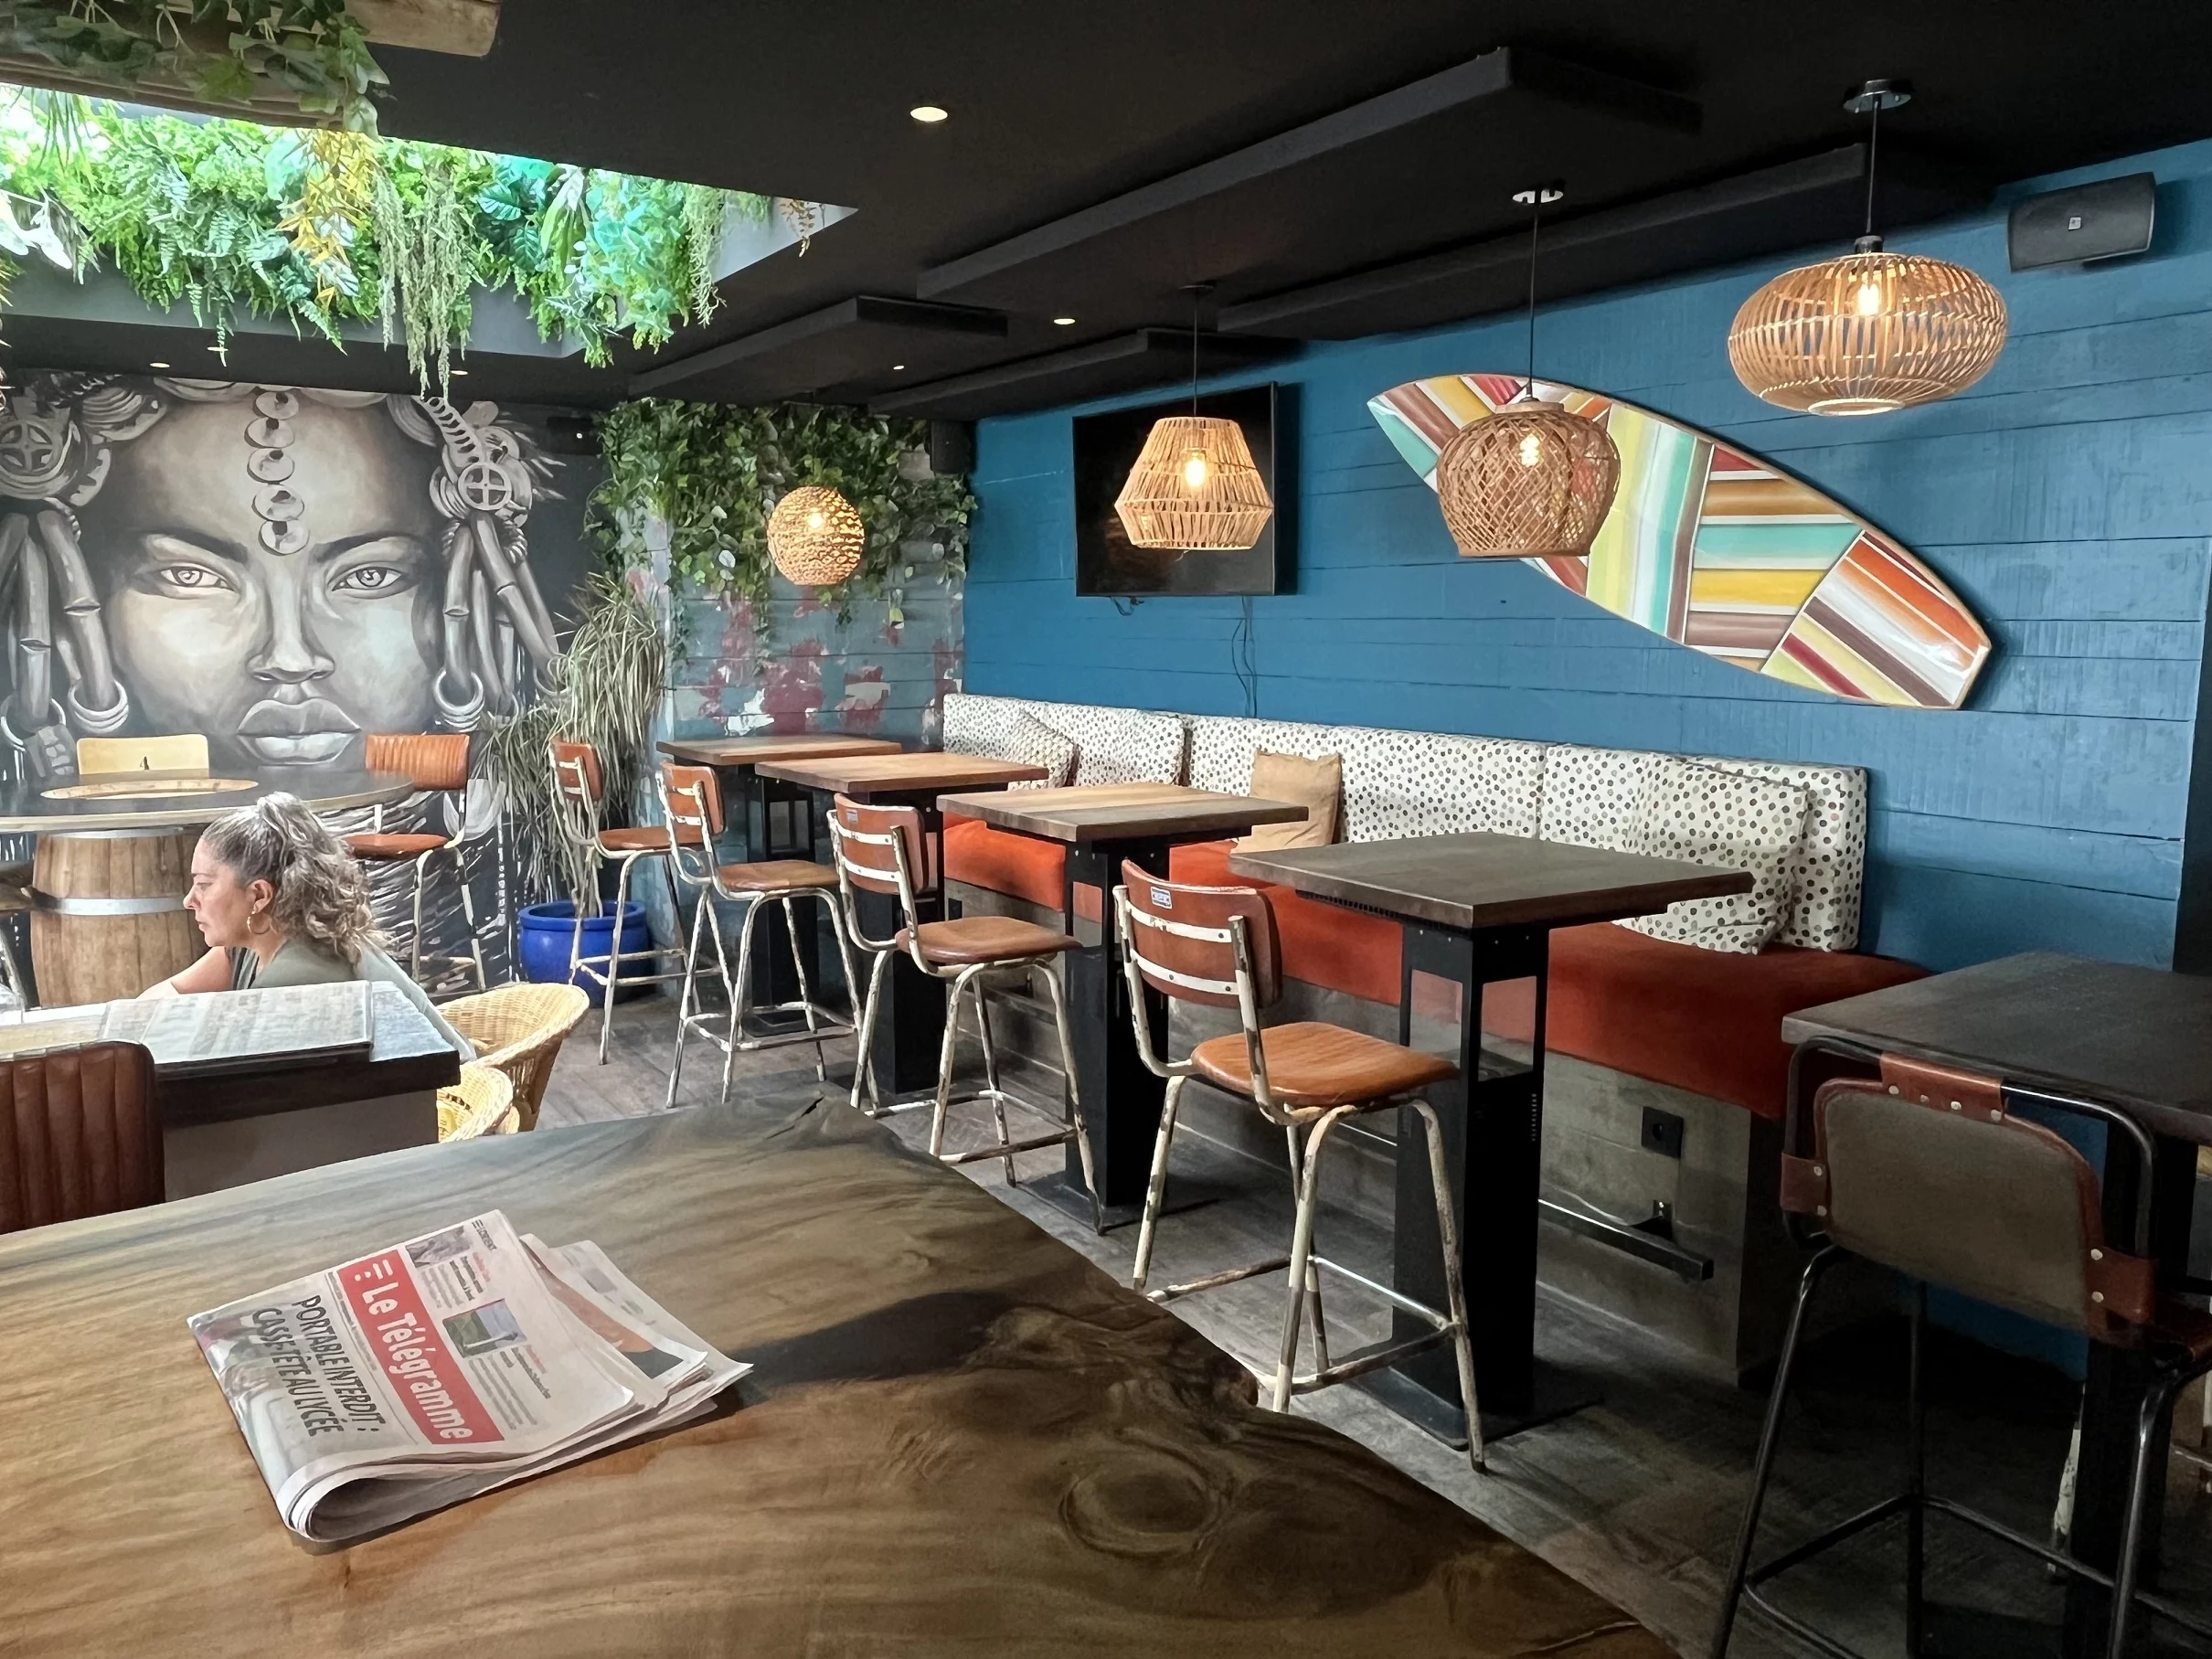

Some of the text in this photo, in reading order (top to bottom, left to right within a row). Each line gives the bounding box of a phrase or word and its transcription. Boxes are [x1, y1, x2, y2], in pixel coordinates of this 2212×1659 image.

[292, 1294, 350, 1367] PORTABLE
[323, 1366, 387, 1424] INTERDIT
[362, 1281, 399, 1315] Le
[252, 1307, 348, 1437] CASSE-TÊTE AU LYCÉE
[377, 1312, 473, 1440] Télégramme
